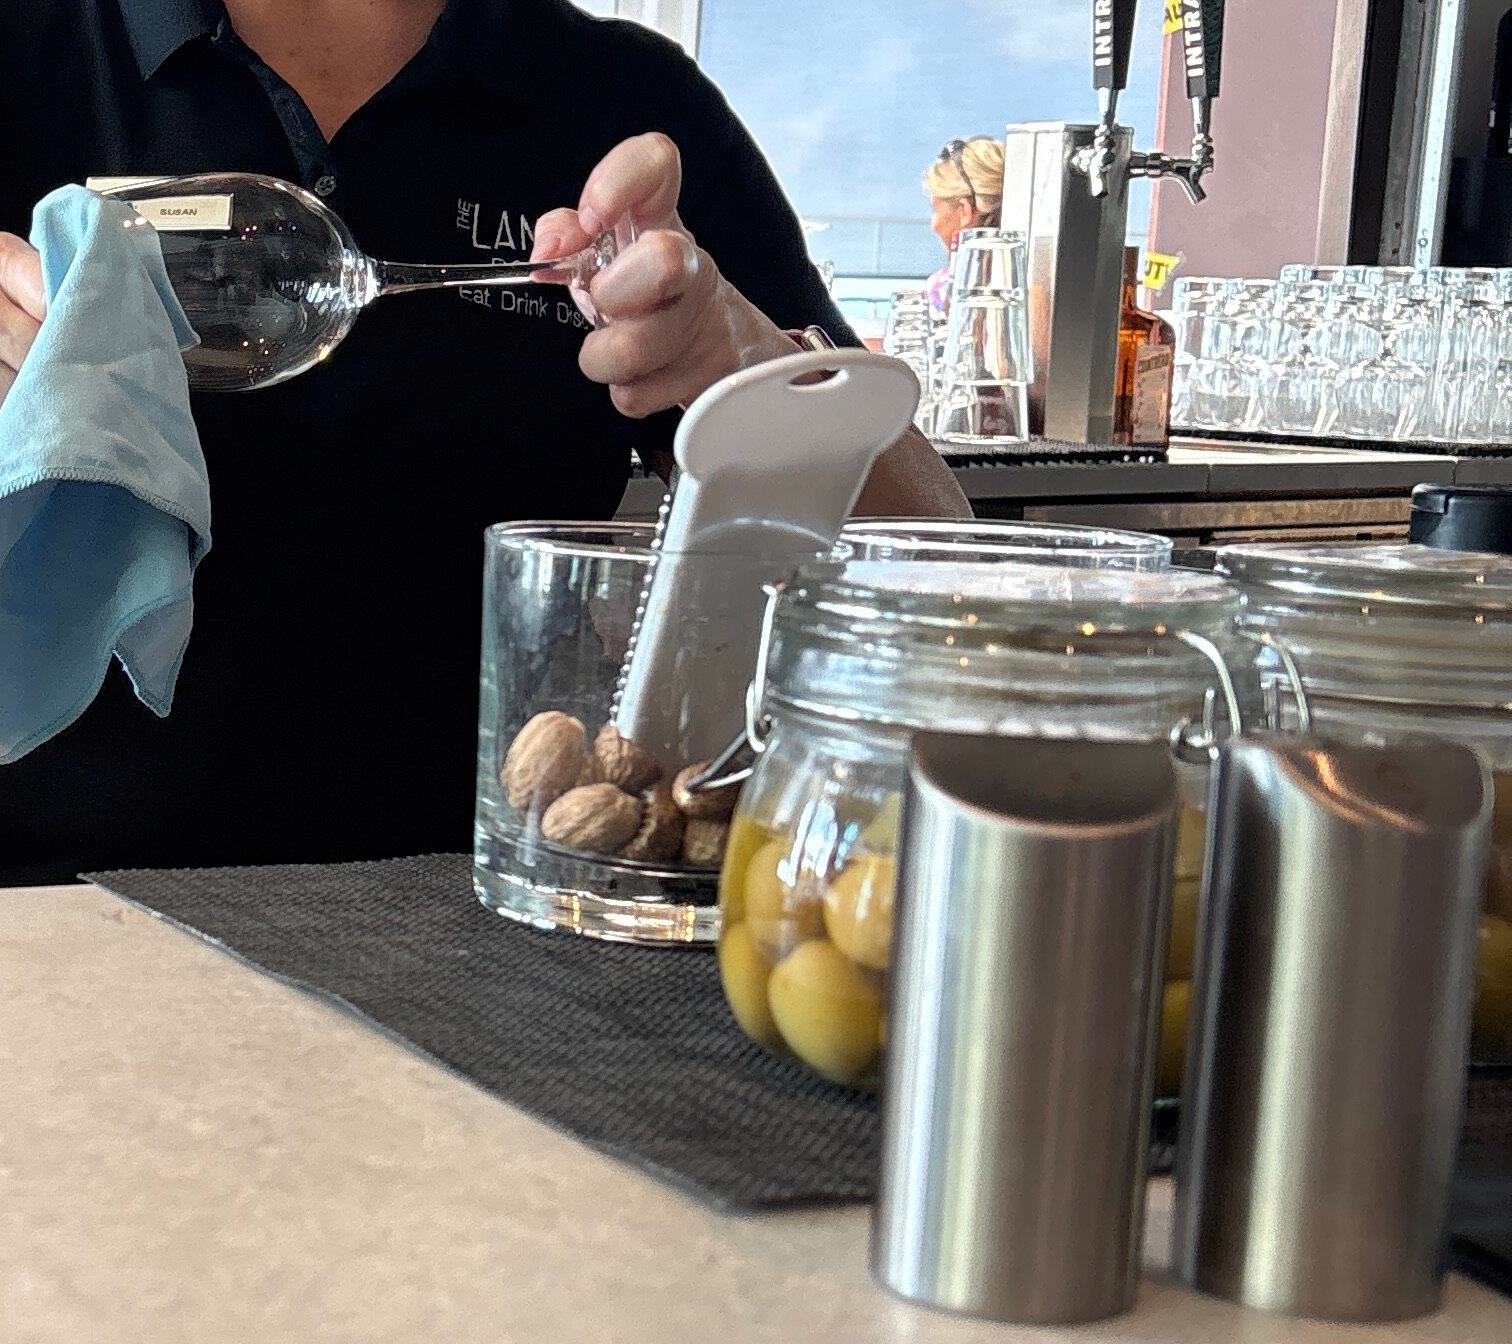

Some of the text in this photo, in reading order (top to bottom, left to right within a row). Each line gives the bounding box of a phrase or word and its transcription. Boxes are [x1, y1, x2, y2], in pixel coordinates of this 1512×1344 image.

[159, 207, 198, 216] SUSAN
[456, 198, 474, 230] THE
[472, 203, 535, 251] LAN
[459, 286, 588, 330] Eat Drink Dis
